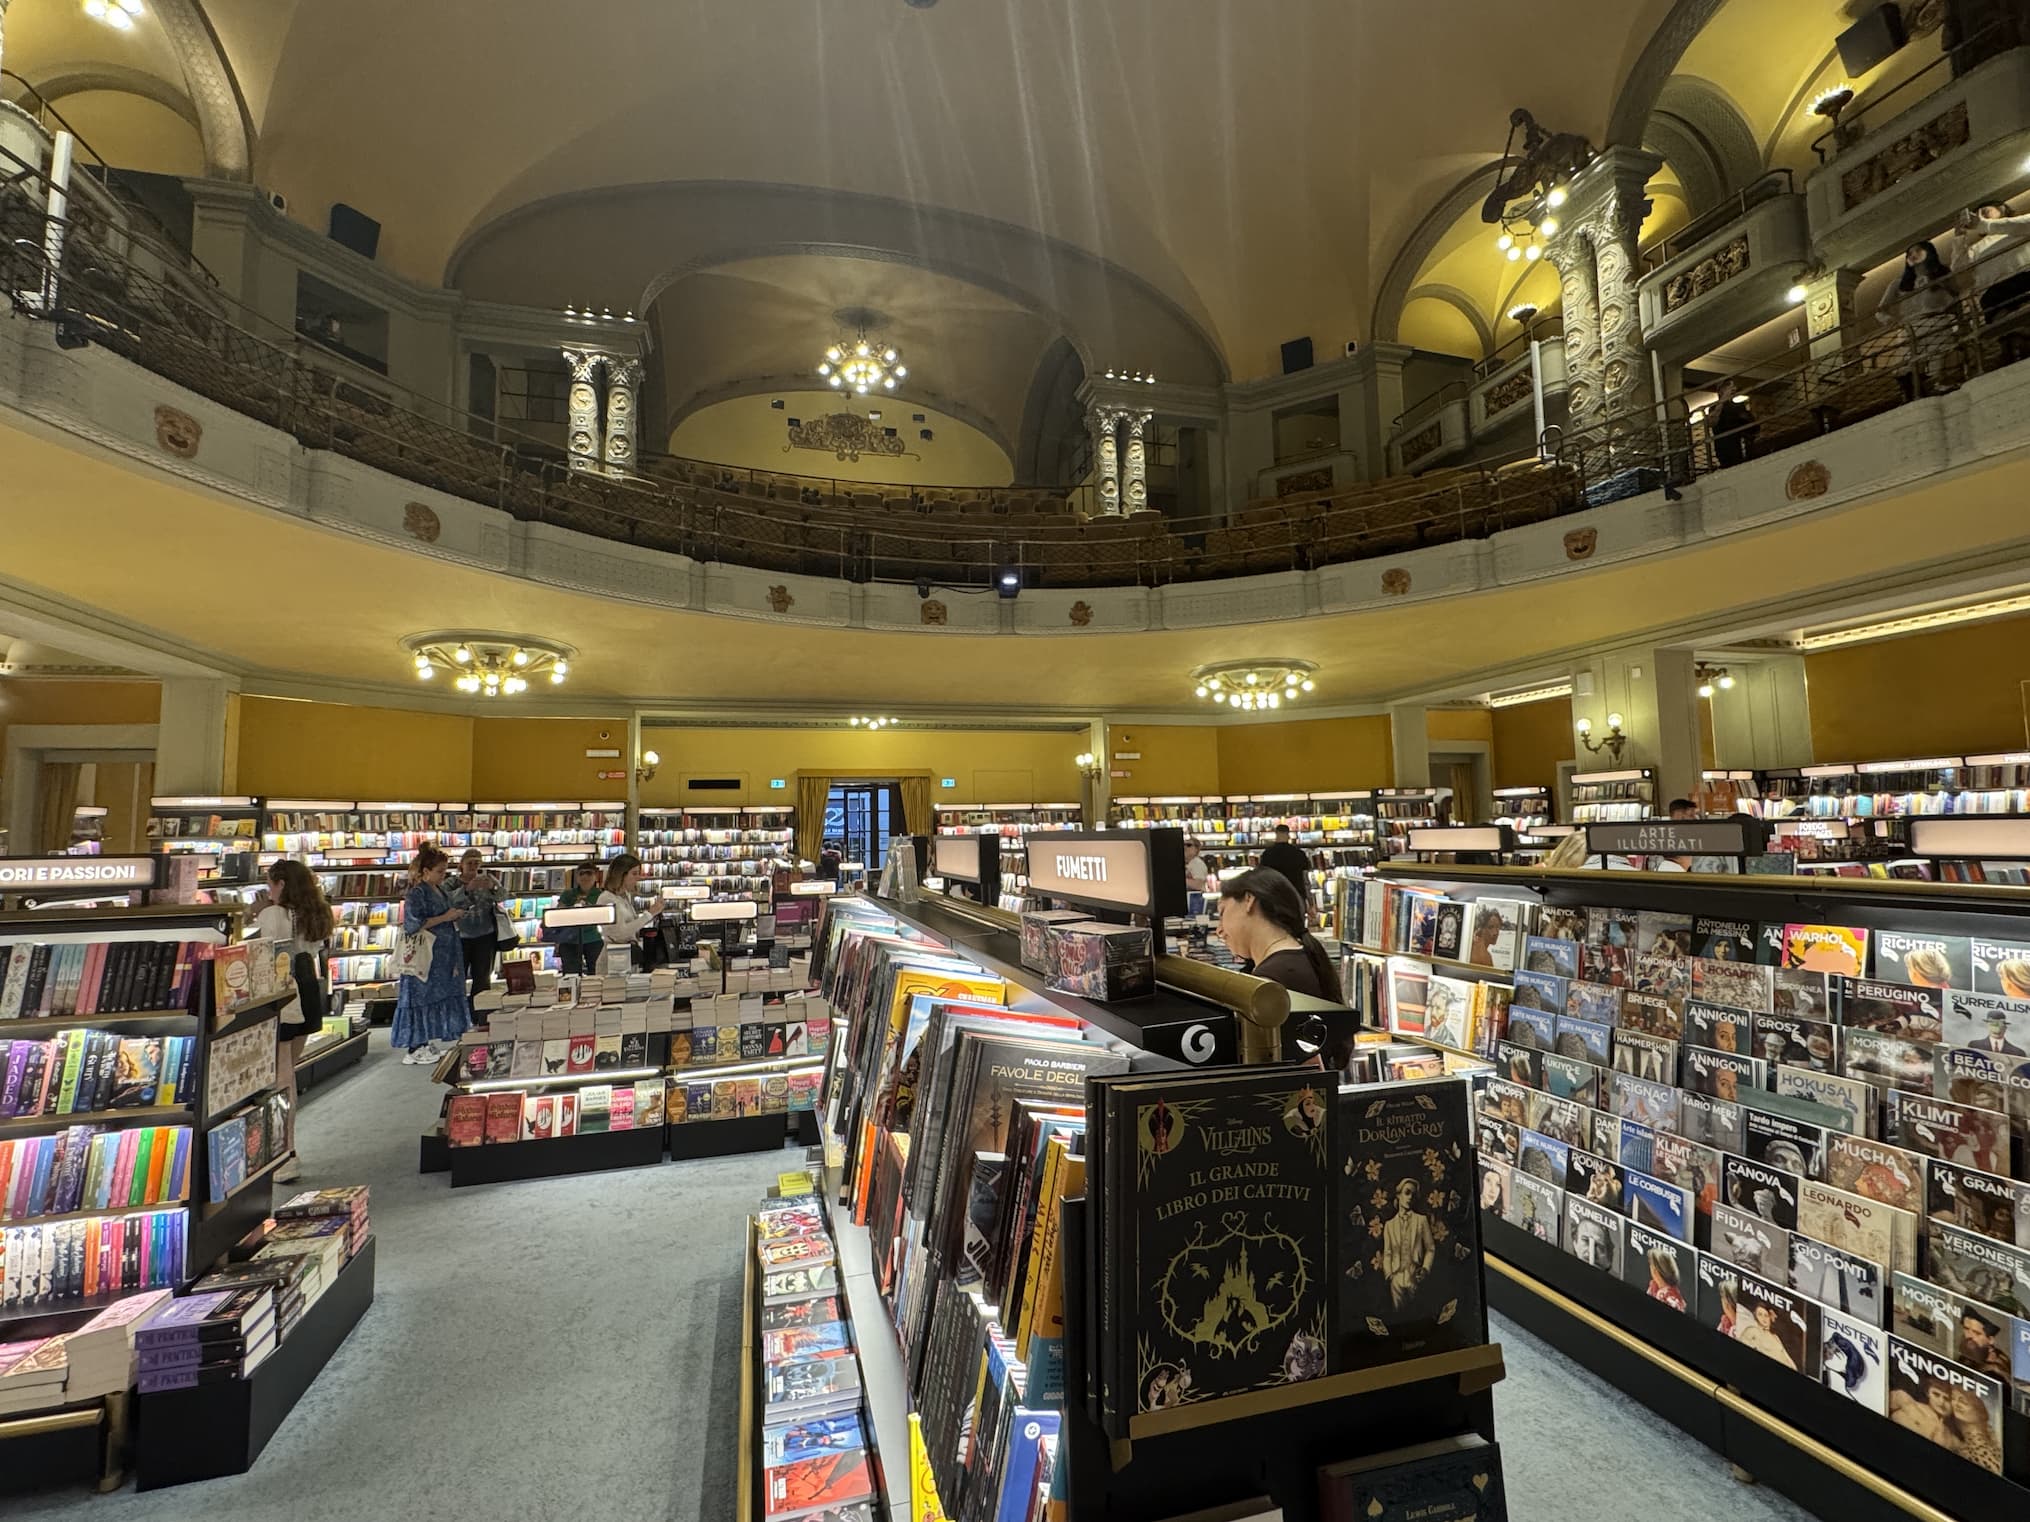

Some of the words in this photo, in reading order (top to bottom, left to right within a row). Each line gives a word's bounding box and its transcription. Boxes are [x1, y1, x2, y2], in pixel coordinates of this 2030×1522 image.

[1617, 838, 1704, 850] ILLUSTRATI
[1639, 827, 1676, 838] ARTE
[37, 867, 48, 880] E
[50, 865, 136, 880] PASSIONI
[1055, 855, 1107, 882] FUMETTI
[1696, 927, 1710, 936] DA
[1711, 928, 1748, 939] MESSINA
[1697, 919, 1750, 932] ANTONELLO
[1789, 930, 1844, 945] WARHOL
[1881, 937, 1947, 953] RICHTER
[1627, 993, 1669, 1009] BRUEGEL
[1857, 985, 1930, 1003] PERUGINO
[1689, 1006, 1748, 1027] ANNIGONI
[1757, 1018, 1801, 1034] GROSZ
[1024, 1058, 1050, 1067] PAOLO
[1499, 1045, 1530, 1060] RICHTER
[1953, 1054, 2005, 1072] BEATO
[991, 1065, 1043, 1081] FAVOLE
[1689, 1053, 1751, 1076] ANNIGONI
[1782, 1073, 1852, 1099] HOKUSAI
[1953, 1066, 2030, 1089] ANGELICO
[1487, 1080, 1525, 1100] KHNOPFF
[1623, 1080, 1668, 1103] SIGNAC
[1478, 1116, 1503, 1131] GROSZ
[1712, 1104, 1738, 1121] MERZ
[1902, 1100, 1963, 1127] KLIMT
[1199, 1126, 1271, 1155] VILLAINS
[1656, 1136, 1692, 1160] KLIMT
[1834, 1140, 1896, 1165] MUCHA
[1189, 1172, 1205, 1188] IL
[1209, 1162, 1279, 1183] GRANDE
[1515, 1174, 1539, 1193] STREET
[1540, 1185, 1554, 1199] ART
[1628, 1174, 1640, 1186] LE
[1727, 1162, 1783, 1188] CANOVA
[1156, 1193, 1207, 1221] LIBRO
[1211, 1187, 1240, 1205] DEI
[1243, 1184, 1311, 1202] CATTIVI
[1803, 1187, 1872, 1218] LEONARDO
[1569, 1201, 1618, 1232] KOUNELLIS
[1716, 1212, 1755, 1236] FIDIA
[1631, 1229, 1678, 1258] RICHTER
[1943, 1232, 2025, 1272] VERONESE
[1795, 1242, 1821, 1261] GIO
[1824, 1253, 1868, 1281] PONTI
[1741, 1279, 1794, 1313] MANET
[1902, 1285, 1962, 1318] MORONI
[1890, 1342, 1990, 1398] KHNOPFF
